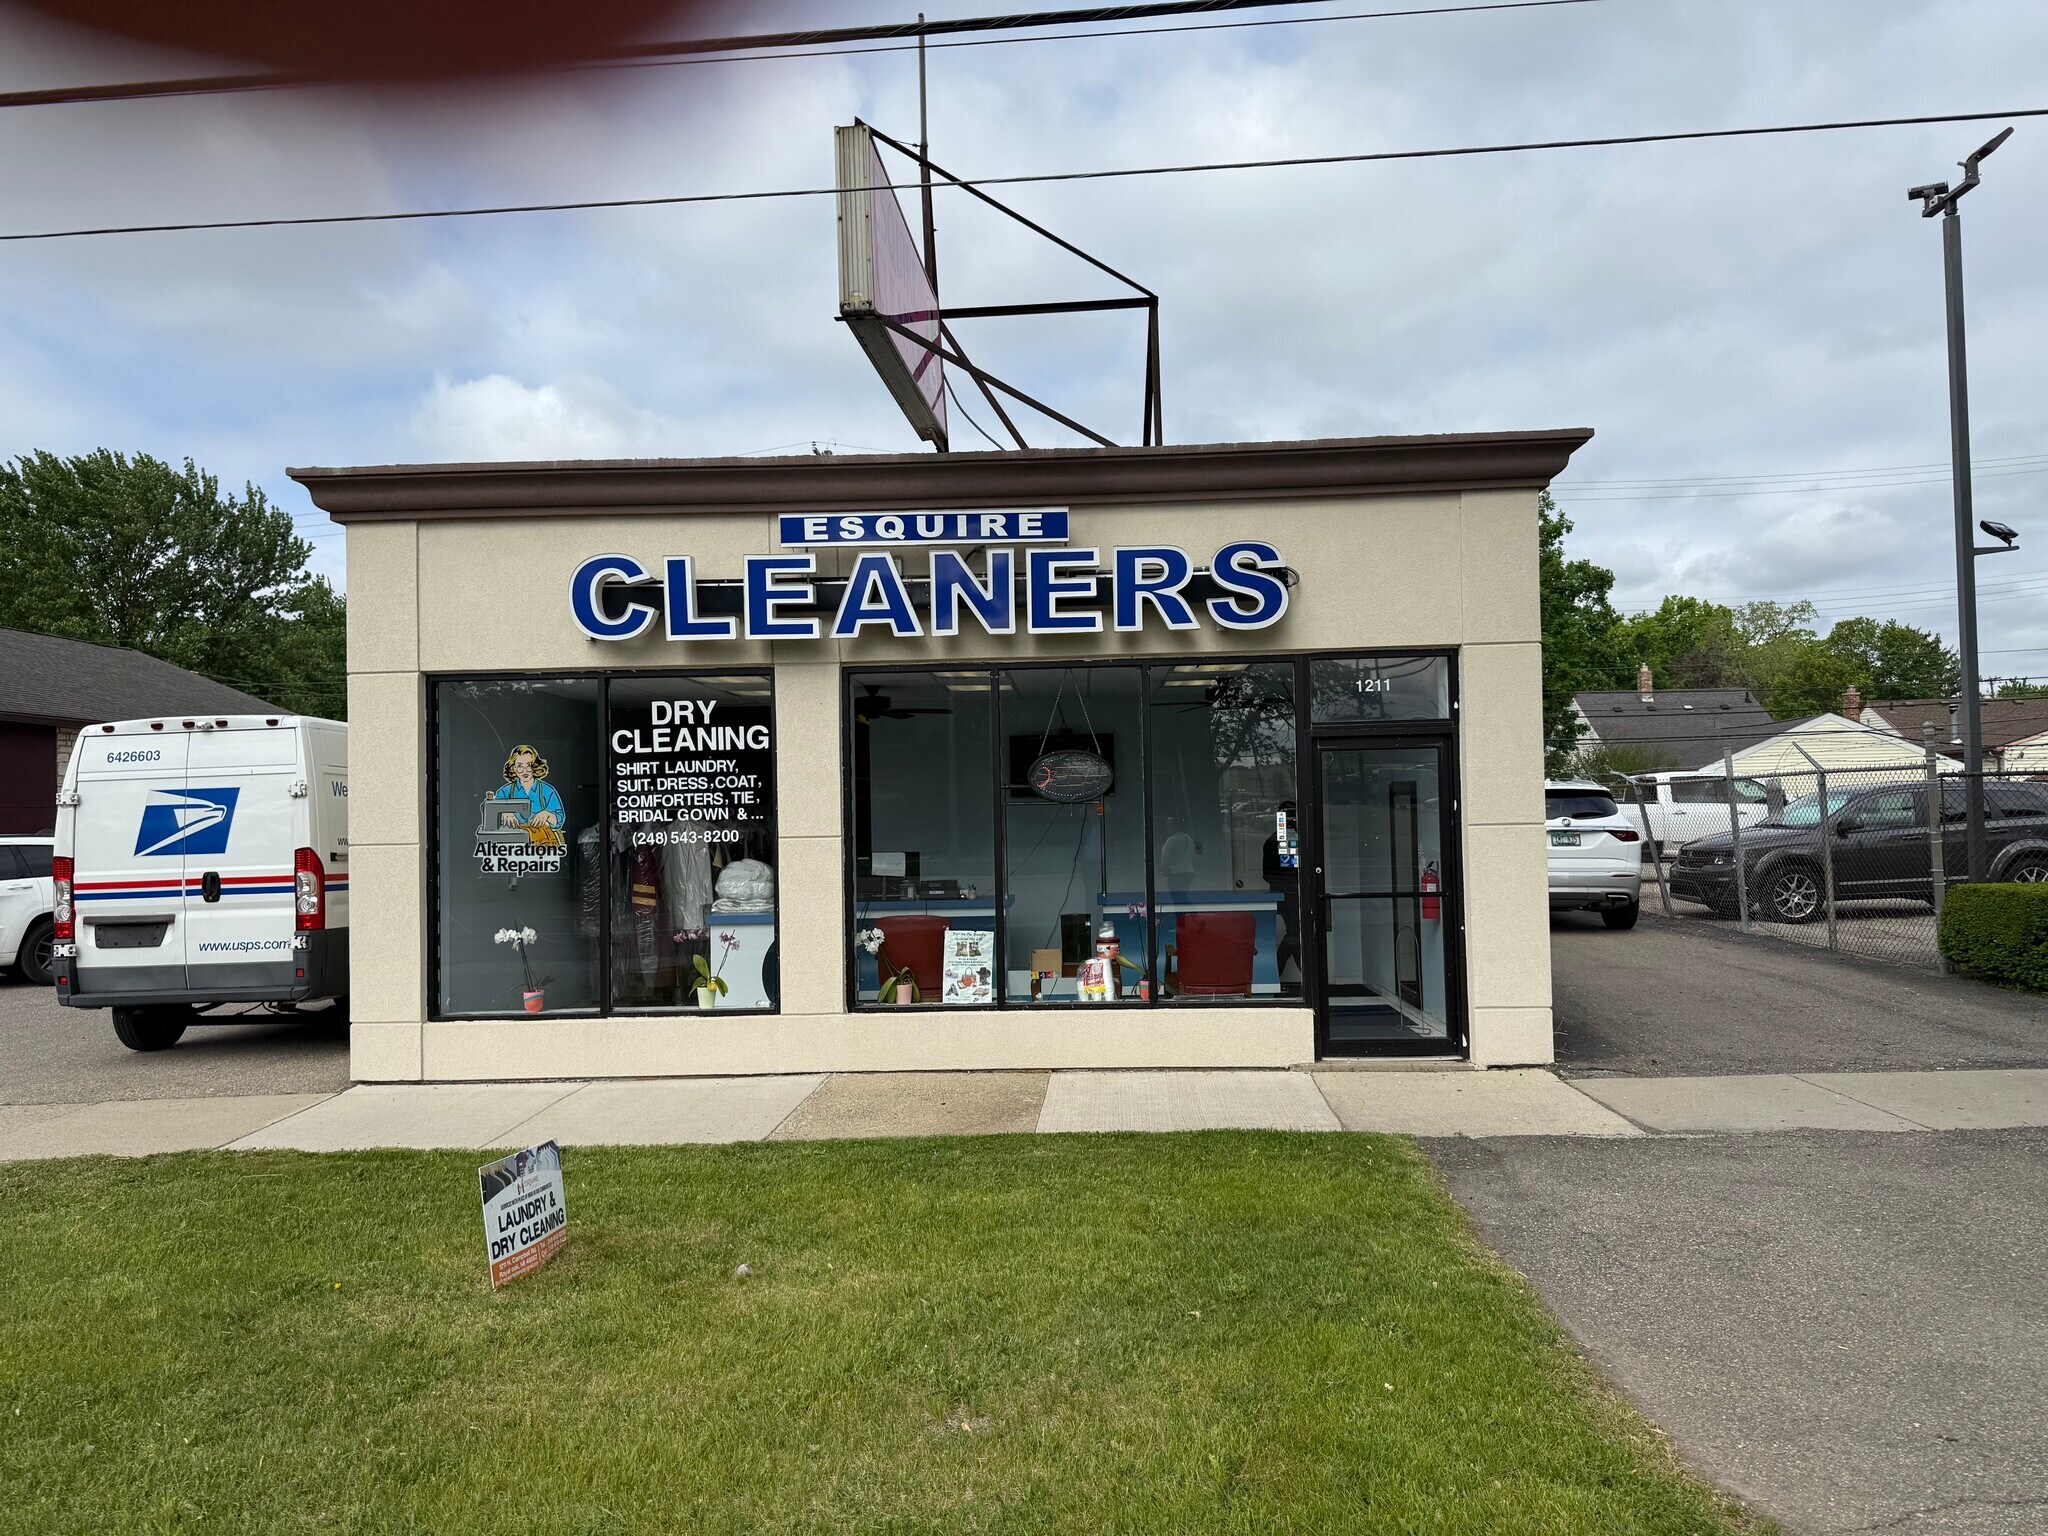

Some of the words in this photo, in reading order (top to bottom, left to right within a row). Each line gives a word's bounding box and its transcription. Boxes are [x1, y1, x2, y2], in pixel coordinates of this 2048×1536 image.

[804, 513, 1044, 541] ESQUIRE
[568, 541, 1290, 642] CLEANERS
[1355, 679, 1390, 692] 1211
[651, 700, 717, 726] DRY
[611, 725, 770, 754] CLEANING
[107, 749, 161, 763] 6426603
[616, 761, 660, 776] SHIRT
[665, 759, 739, 774] LAUNDRY,
[617, 778, 654, 792] SUIT,
[616, 792, 729, 808] COMFORTERS,
[731, 791, 760, 804] TIE,
[618, 809, 673, 823] BRIDAL
[677, 807, 729, 821] GOWN
[632, 831, 668, 847] (248)
[670, 829, 740, 844] 543-8200
[474, 841, 567, 856] Alterations
[481, 857, 495, 872] &
[497, 857, 559, 877] Repairs
[198, 940, 290, 953] www.usps.com
[498, 1195, 547, 1233] LAUNDRY
[550, 1190, 557, 1208] &
[491, 1231, 517, 1260] DRY
[519, 1207, 565, 1246] CLEANING
